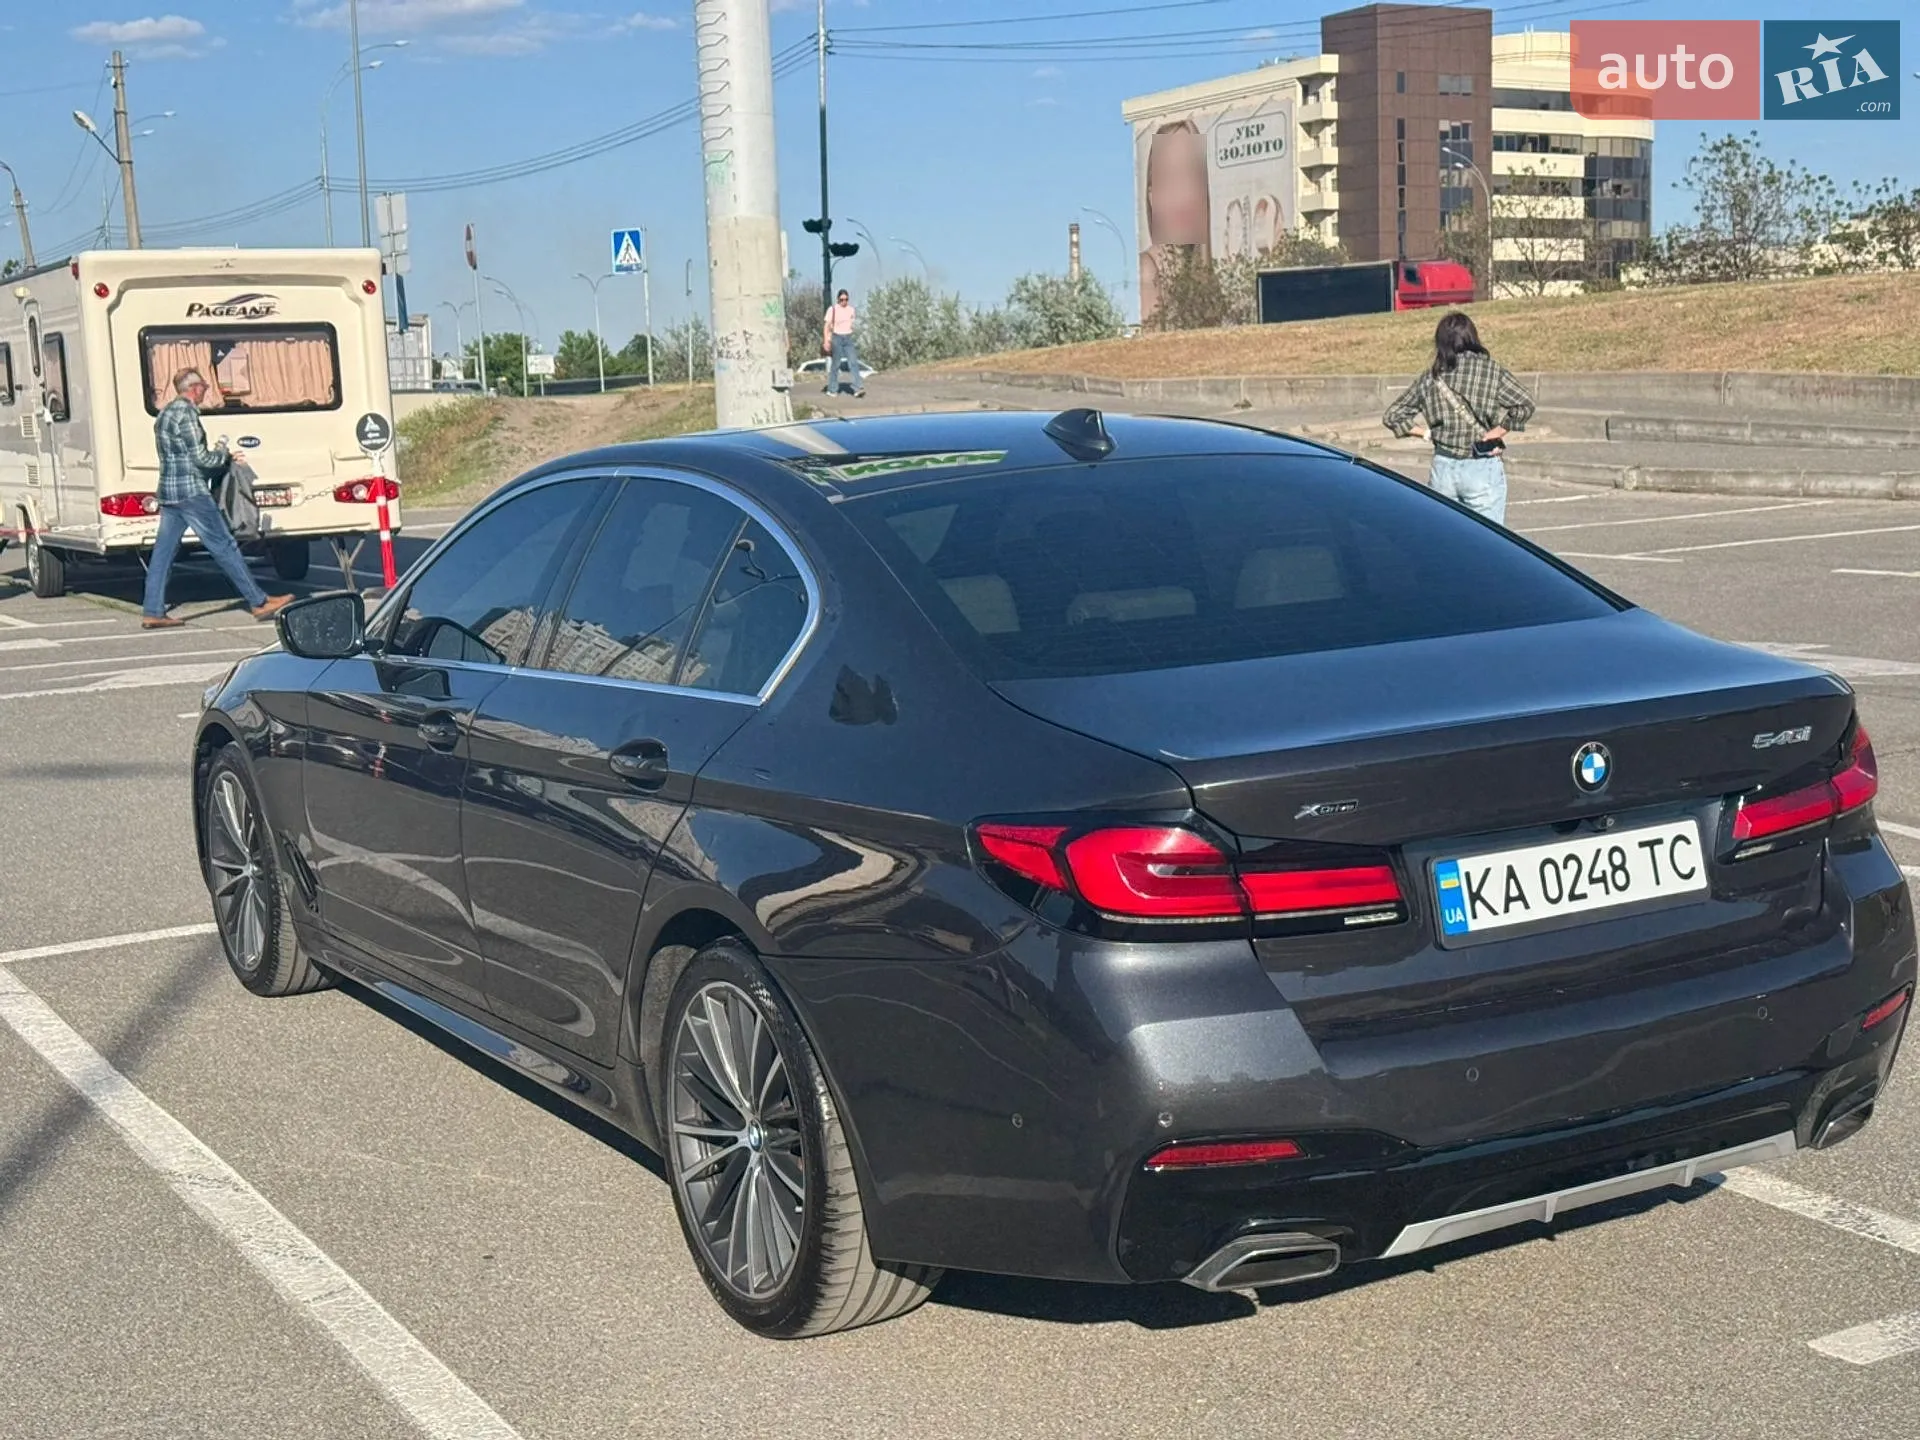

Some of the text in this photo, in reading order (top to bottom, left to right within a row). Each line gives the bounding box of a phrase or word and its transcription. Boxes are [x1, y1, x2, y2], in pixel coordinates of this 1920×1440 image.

[1234, 123, 1265, 141] УКР
[1219, 138, 1283, 161] ЗОЛОТО
[186, 302, 276, 317] PAGEANT
[1464, 833, 1696, 920] KA 0248 TC
[1445, 909, 1466, 924] UA
